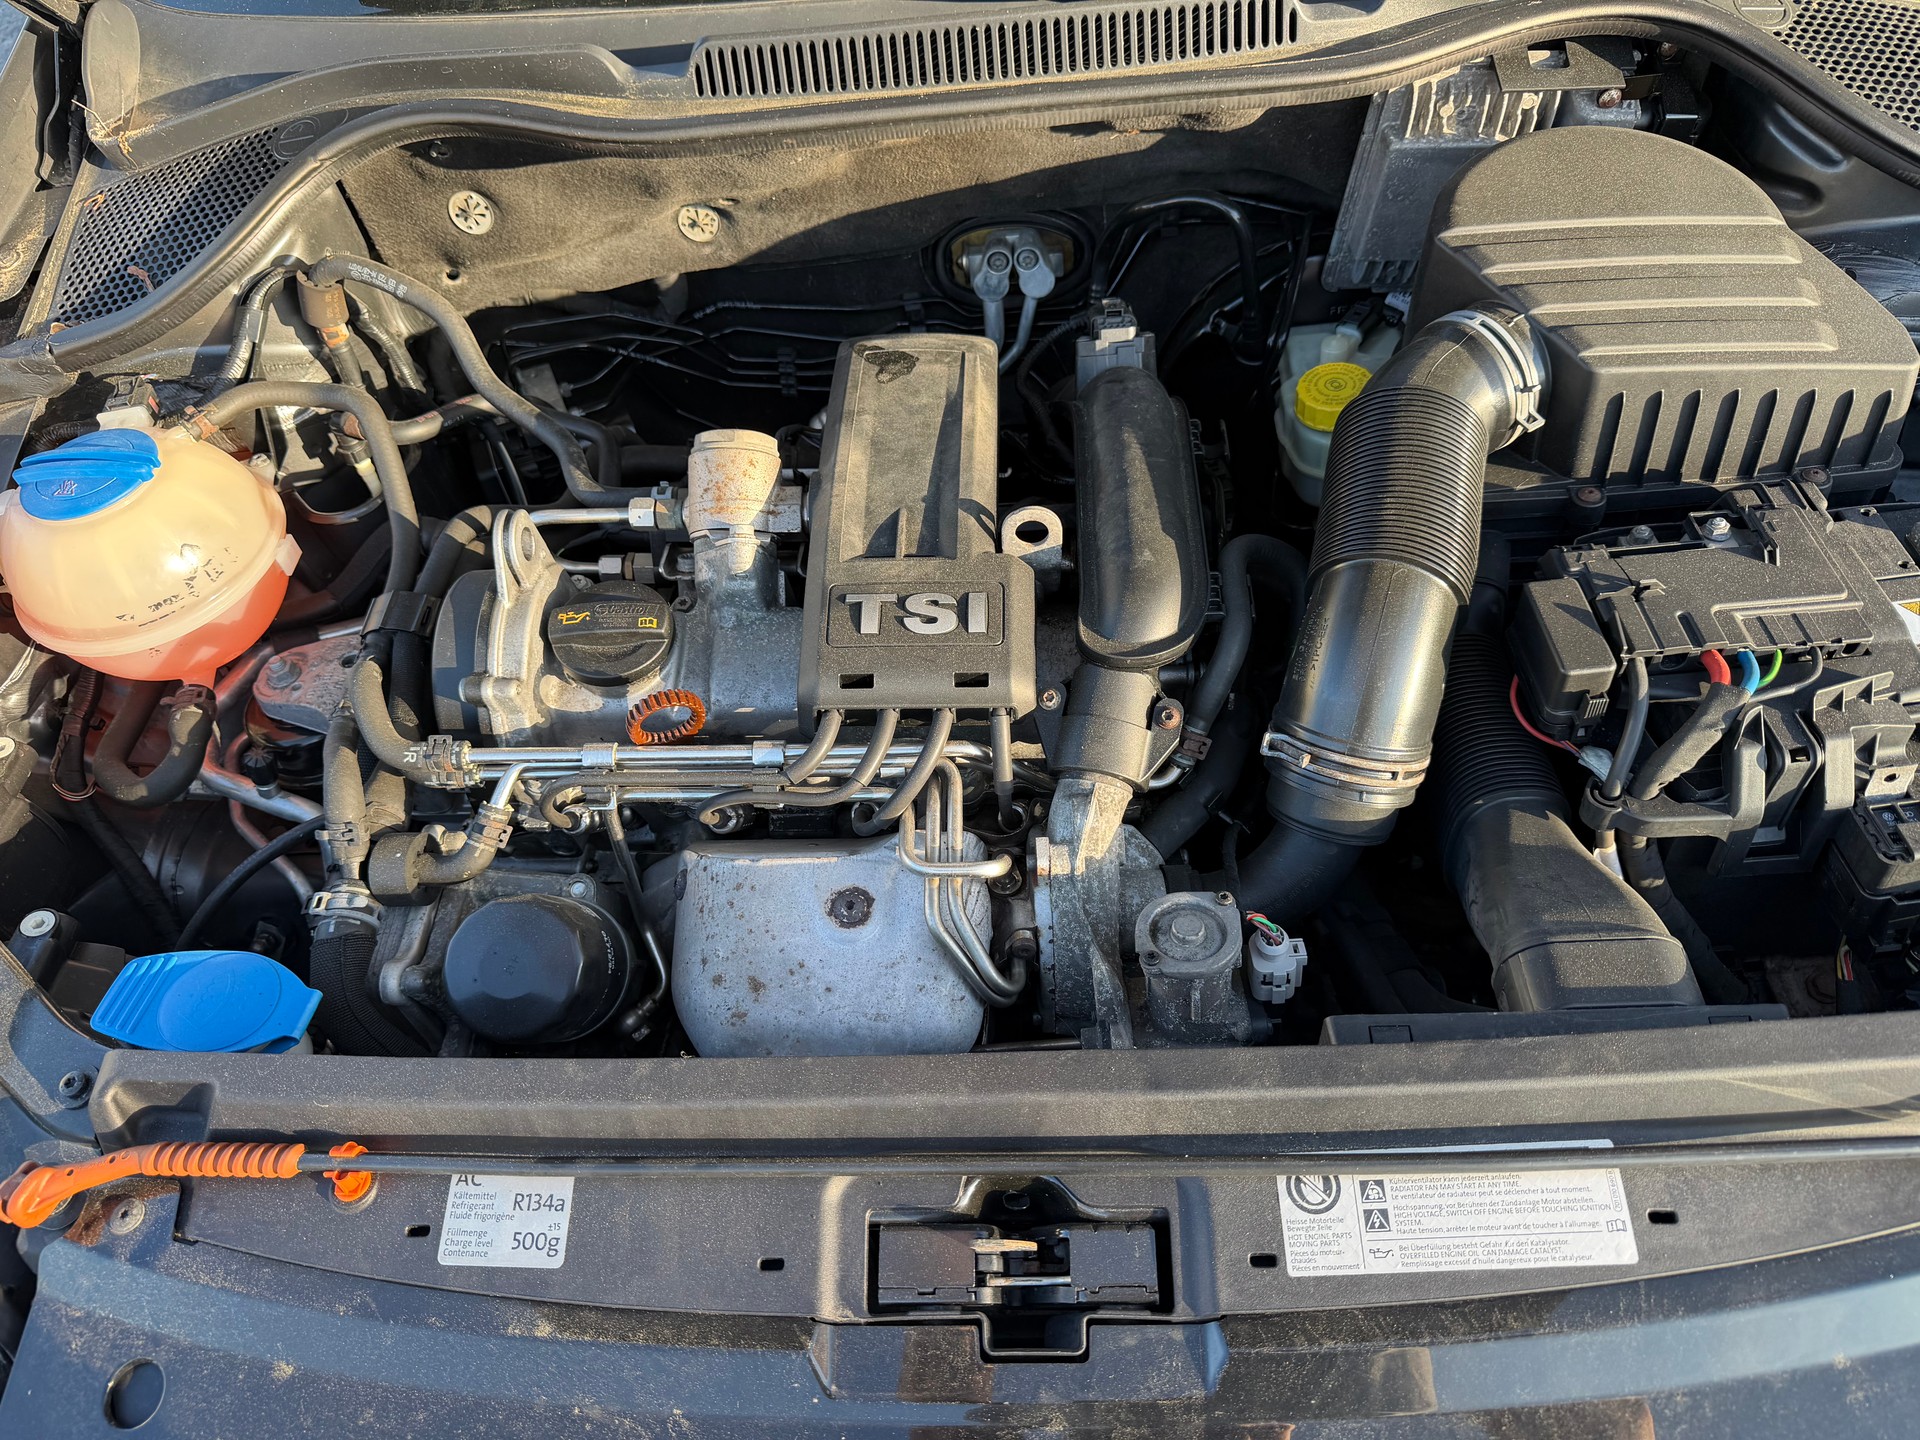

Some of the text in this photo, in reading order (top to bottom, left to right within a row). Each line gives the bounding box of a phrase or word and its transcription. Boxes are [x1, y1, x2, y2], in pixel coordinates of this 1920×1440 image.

[844, 593, 988, 634] TSI
[455, 1174, 482, 1186] AC
[454, 1192, 496, 1200] Kältemittel
[1478, 1190, 1494, 1198] peut
[452, 1201, 494, 1211] Refrigerant
[513, 1193, 565, 1212] R134a
[1515, 1206, 1540, 1214] BEFORE
[450, 1211, 515, 1222] Fluide frigorigène
[548, 1223, 561, 1231] ±15
[1287, 1225, 1316, 1233] Bewegte
[447, 1228, 487, 1239] Füllmenge
[445, 1238, 493, 1247] Charge level
[512, 1232, 560, 1258] 500g
[443, 1248, 488, 1258] Contenance
[1401, 1260, 1443, 1268] Remplissage
[1496, 1257, 1531, 1265] dangereux
